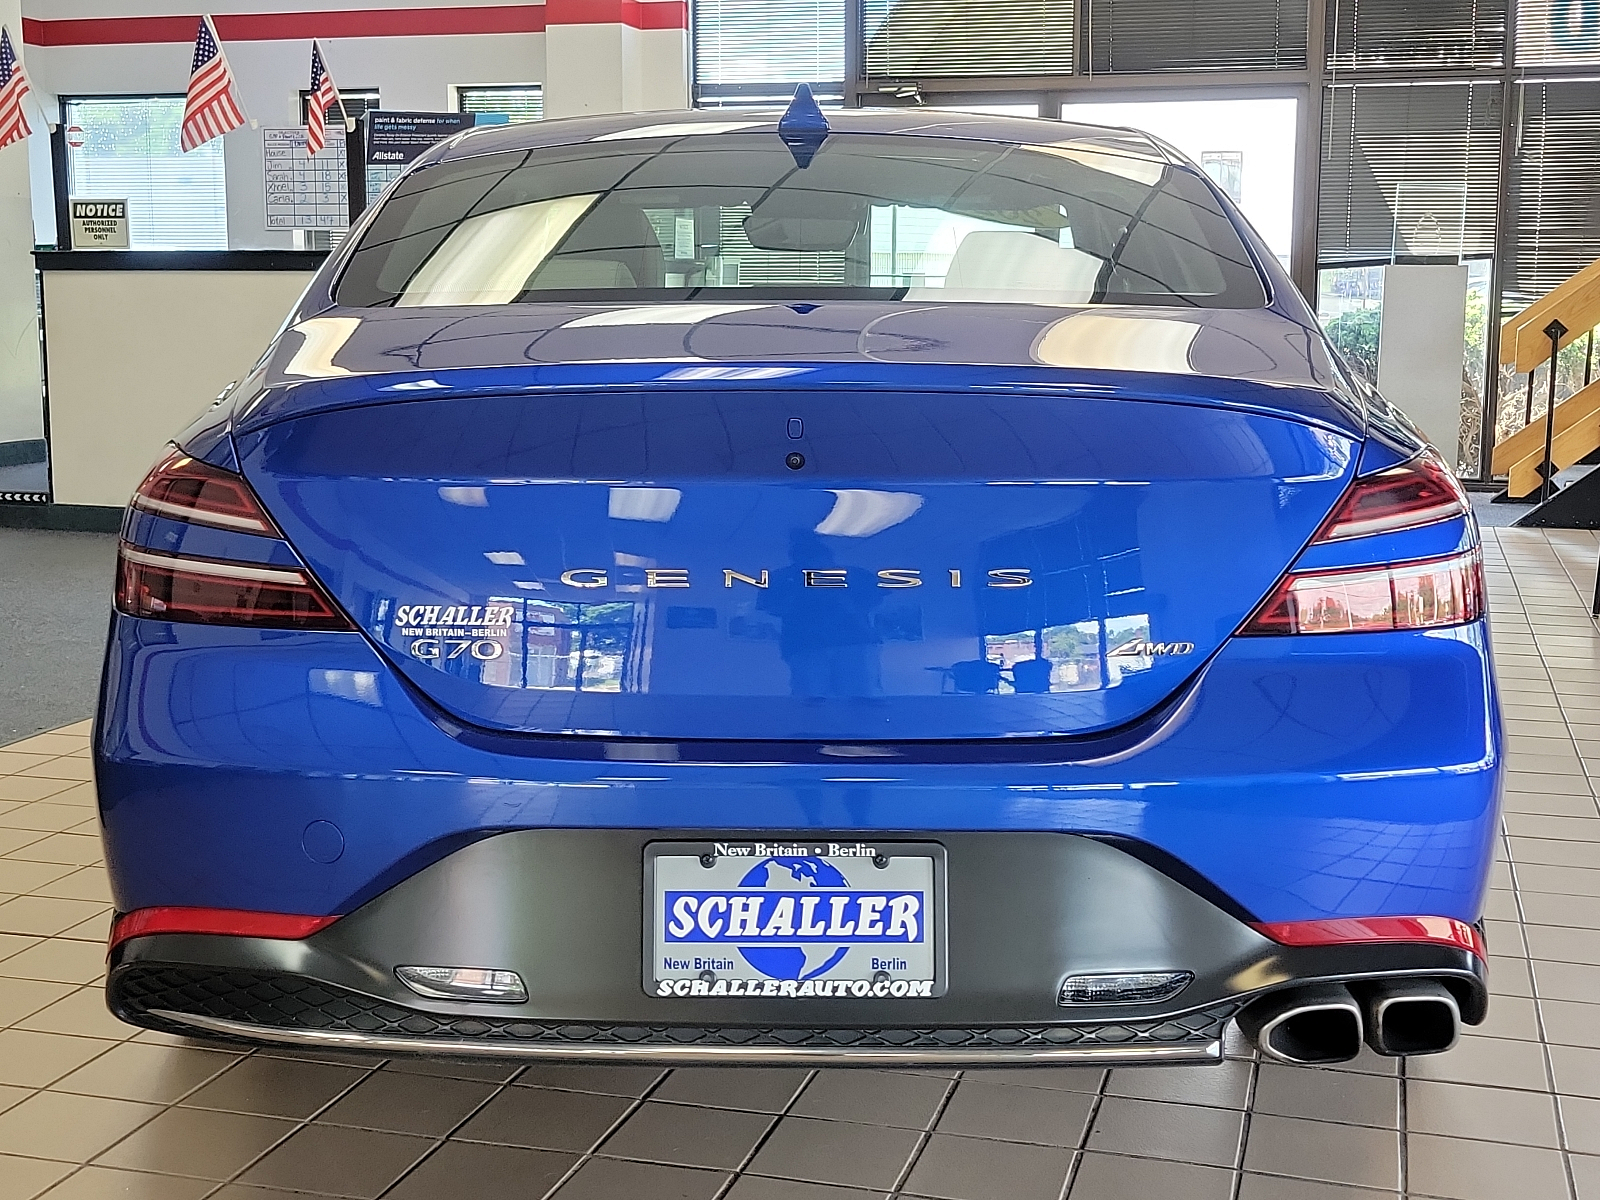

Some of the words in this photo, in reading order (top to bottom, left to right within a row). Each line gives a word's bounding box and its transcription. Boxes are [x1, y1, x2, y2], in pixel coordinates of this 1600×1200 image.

[372, 152, 404, 160] Allstate
[267, 160, 282, 170] Jim
[322, 171, 332, 180] 18
[76, 204, 123, 217] NOTICE
[559, 568, 1035, 590] GENESIS
[395, 605, 515, 628] SCHALLER
[402, 628, 423, 636] NEW
[410, 639, 503, 660] G70
[713, 843, 751, 857] New
[754, 844, 808, 857] Britain
[827, 844, 876, 857] Berlin
[668, 895, 919, 942] SCHALLER
[664, 957, 690, 970] New
[694, 958, 734, 970] Britain
[871, 958, 907, 970] Berlin
[657, 980, 934, 998] SCHALLERAUTO.COM
